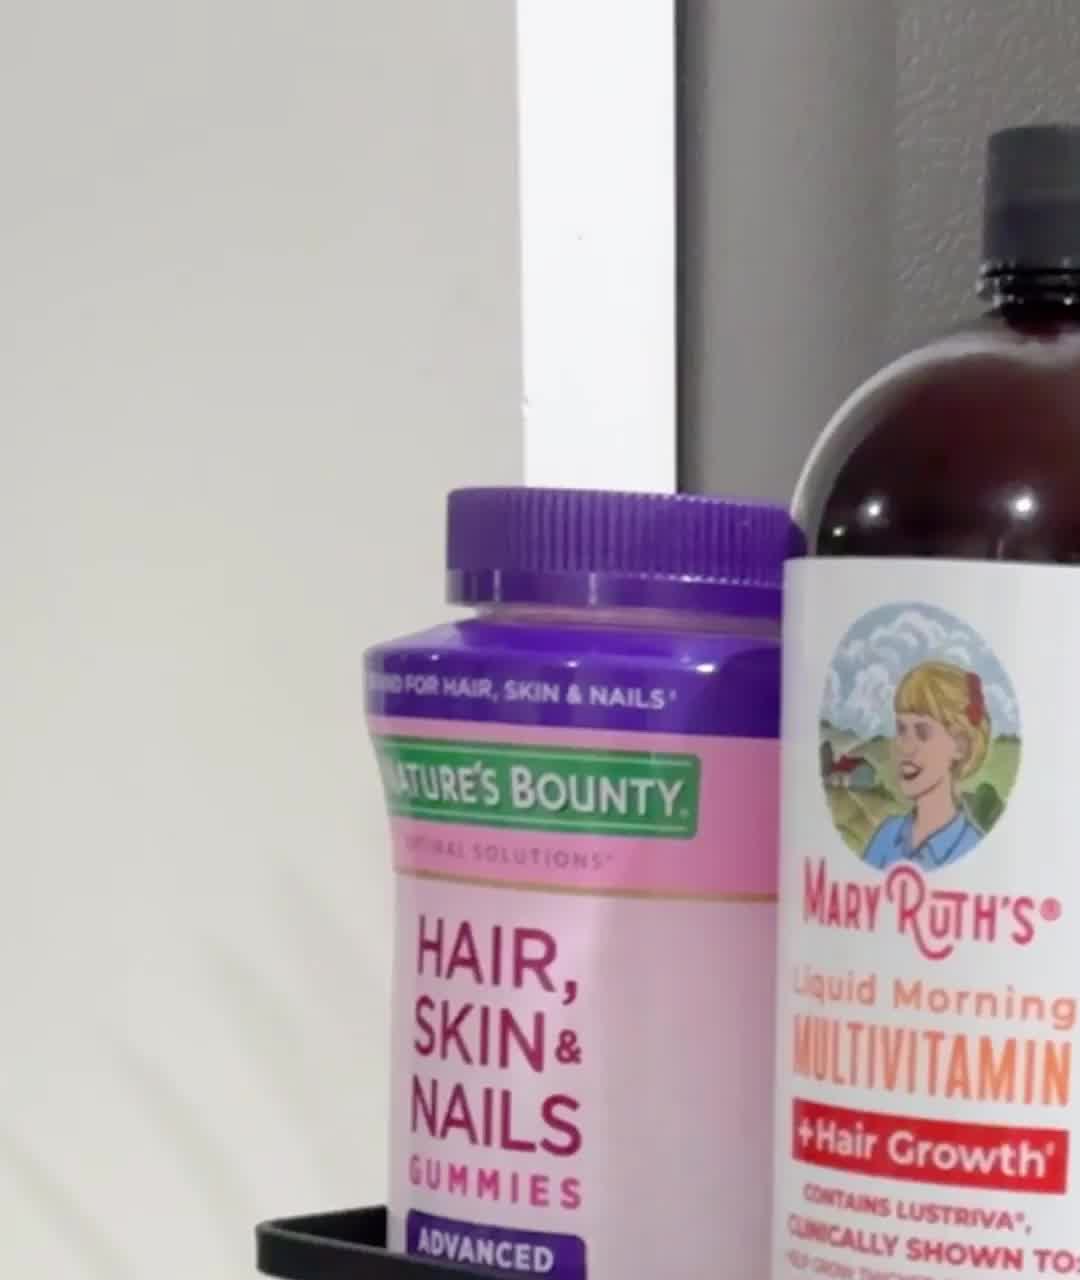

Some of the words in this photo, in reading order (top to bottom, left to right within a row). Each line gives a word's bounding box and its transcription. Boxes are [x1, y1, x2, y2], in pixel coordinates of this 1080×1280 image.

[404, 673, 440, 696] FOR
[444, 676, 498, 702] HAIR,
[504, 679, 559, 704] SKIN
[566, 683, 583, 705] &
[510, 765, 685, 816] BOUNTY
[417, 914, 578, 1005] HAIR,
[794, 967, 877, 1006] Liquid
[893, 977, 1077, 1030] Morning
[413, 995, 545, 1072] SKIN
[555, 1029, 582, 1064] &
[792, 1013, 1072, 1107] MULTIVITAMIN
[411, 1074, 582, 1157] NAILS
[409, 1154, 583, 1210] GUMMIES
[803, 1183, 891, 1218] CONTAINS
[417, 1227, 554, 1273] ADVANCED
[787, 1214, 899, 1257] CLINICALLY
[906, 1237, 1024, 1271] SHOWN
